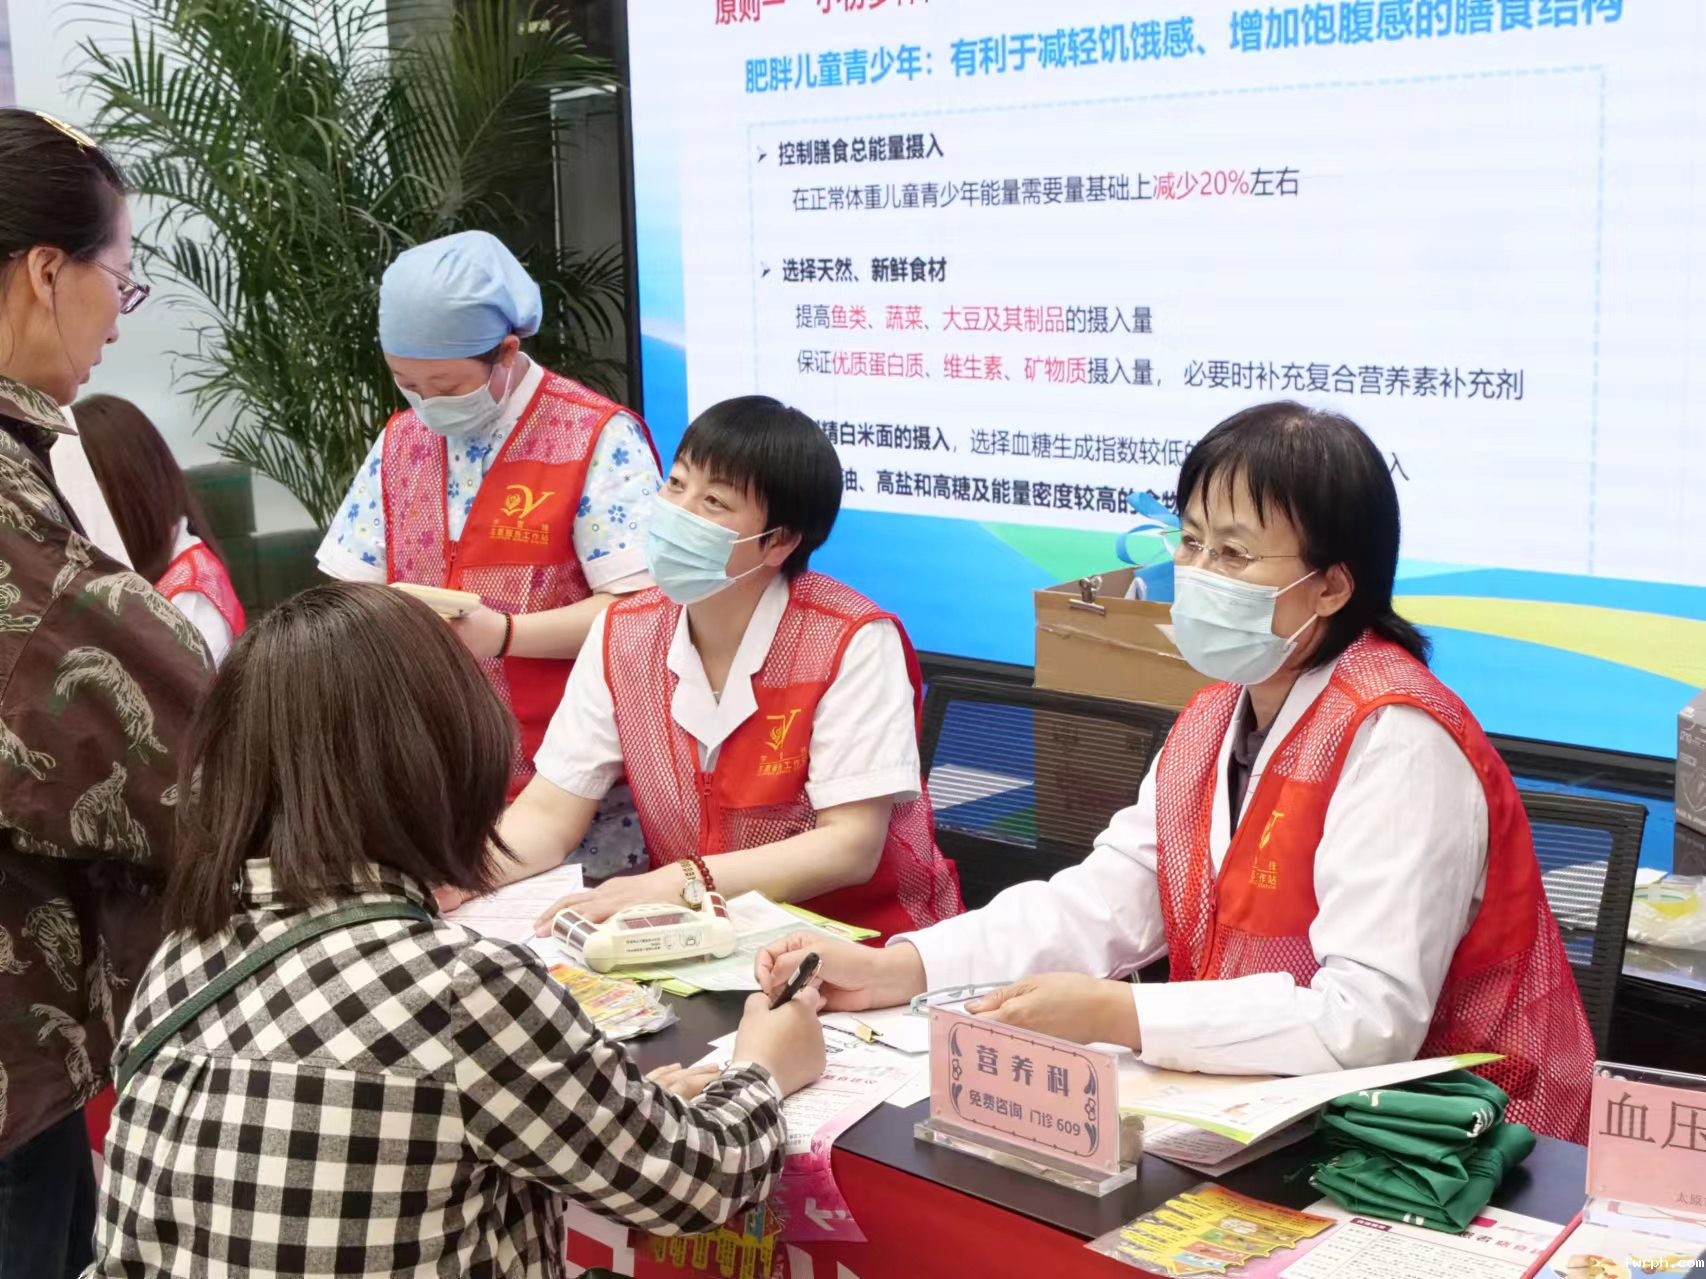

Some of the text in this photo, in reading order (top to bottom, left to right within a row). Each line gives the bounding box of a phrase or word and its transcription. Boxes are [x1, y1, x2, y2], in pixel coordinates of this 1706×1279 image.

[715, 0, 787, 26] 原则一
[779, 133, 946, 168] 控制膳食总能量摄入
[793, 167, 1300, 213] 在正常体重儿童青少年能量需要量基础上减少20%左右
[783, 256, 948, 284] 选择天然、新鲜食材
[796, 304, 1154, 335] 提高鱼类、蔬菜、大豆及其制品的摄入量
[976, 1045, 1070, 1097] 营养科
[969, 1089, 1023, 1121] 免费咨询
[1056, 1118, 1081, 1137] 609
[1598, 1091, 1706, 1153] 血压
